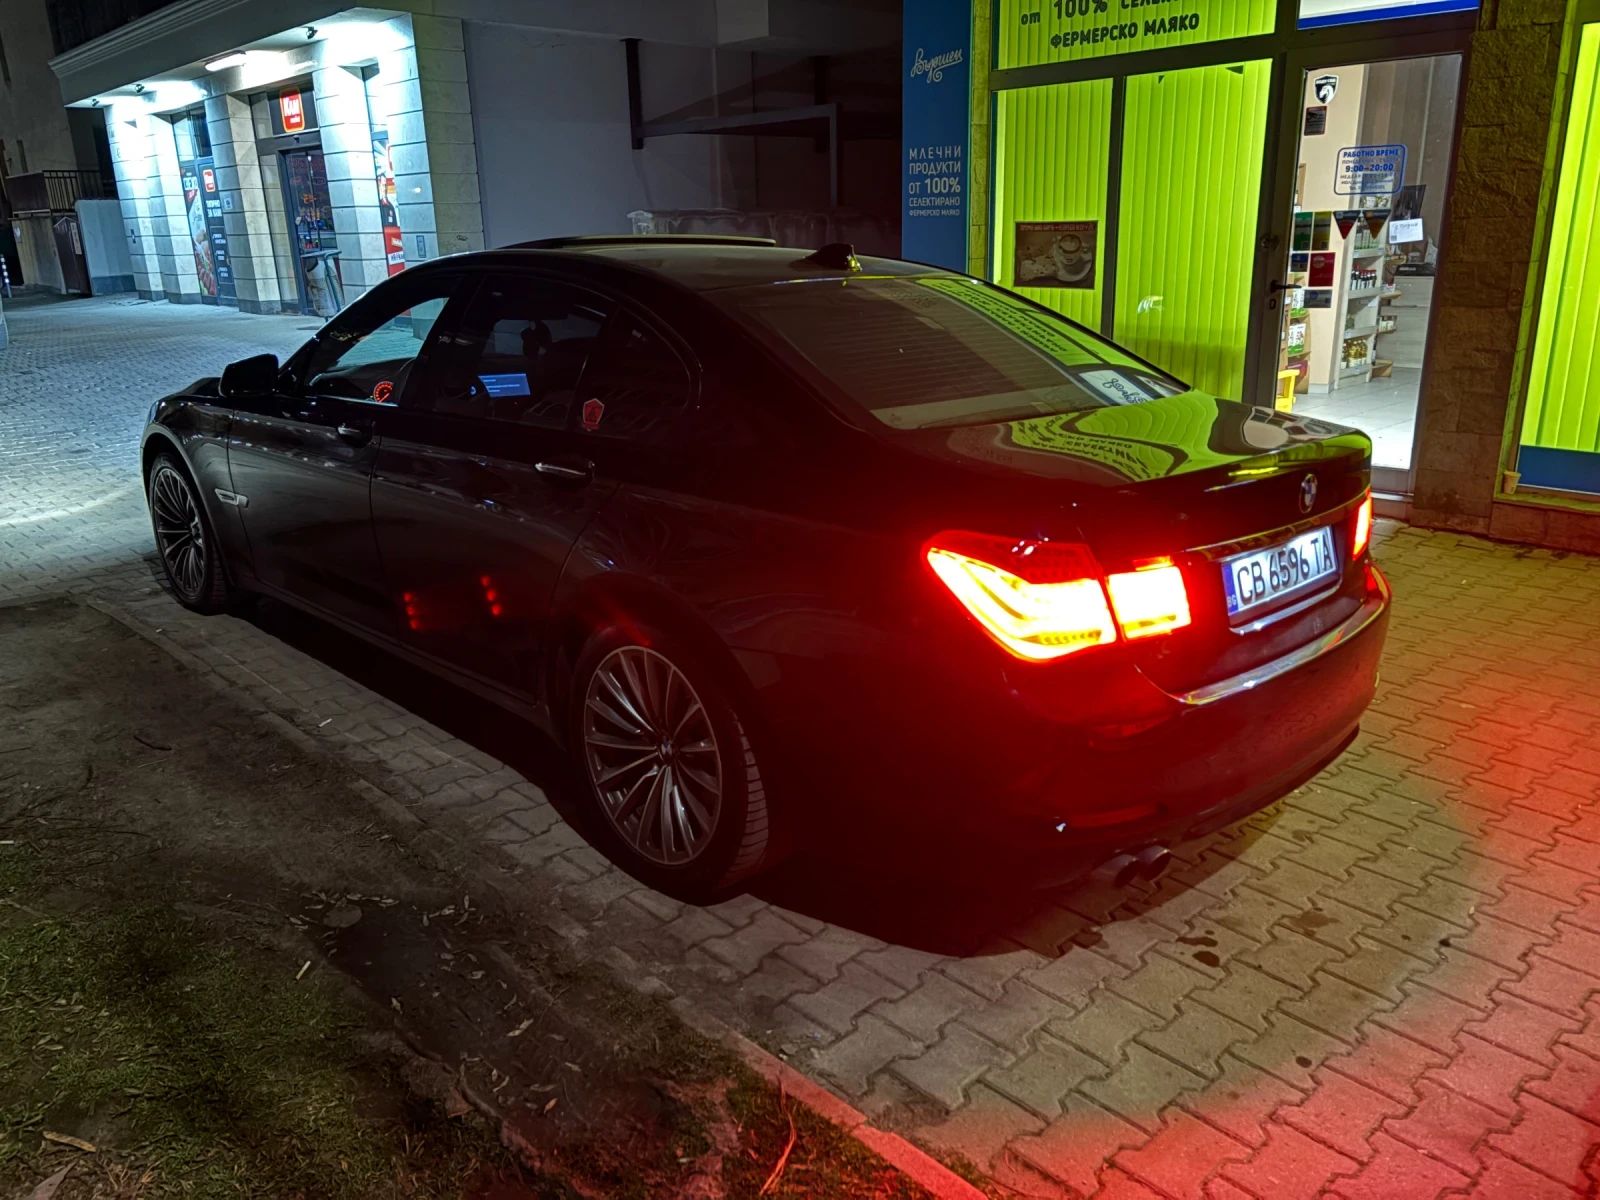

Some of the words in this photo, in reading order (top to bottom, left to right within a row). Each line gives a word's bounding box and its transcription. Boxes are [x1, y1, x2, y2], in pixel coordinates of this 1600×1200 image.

[1020, 11, 1041, 25] от
[1053, 0, 1108, 20] 100%
[1050, 22, 1138, 49] ФЕРМЕРСКО
[1143, 13, 1200, 37] МЛЯКО
[909, 145, 961, 160] МЛЕЧНИ
[1343, 150, 1375, 158] РАБОТНО
[909, 161, 961, 176] ПРОДУКТИ
[908, 182, 921, 194] ОТ
[924, 177, 961, 194] 100%
[909, 196, 960, 207] СЕЛЕКТИРАНО
[909, 209, 940, 217] ФЕРМЕРСКО
[1269, 544, 1311, 593] 6596
[1226, 594, 1237, 608] BG
